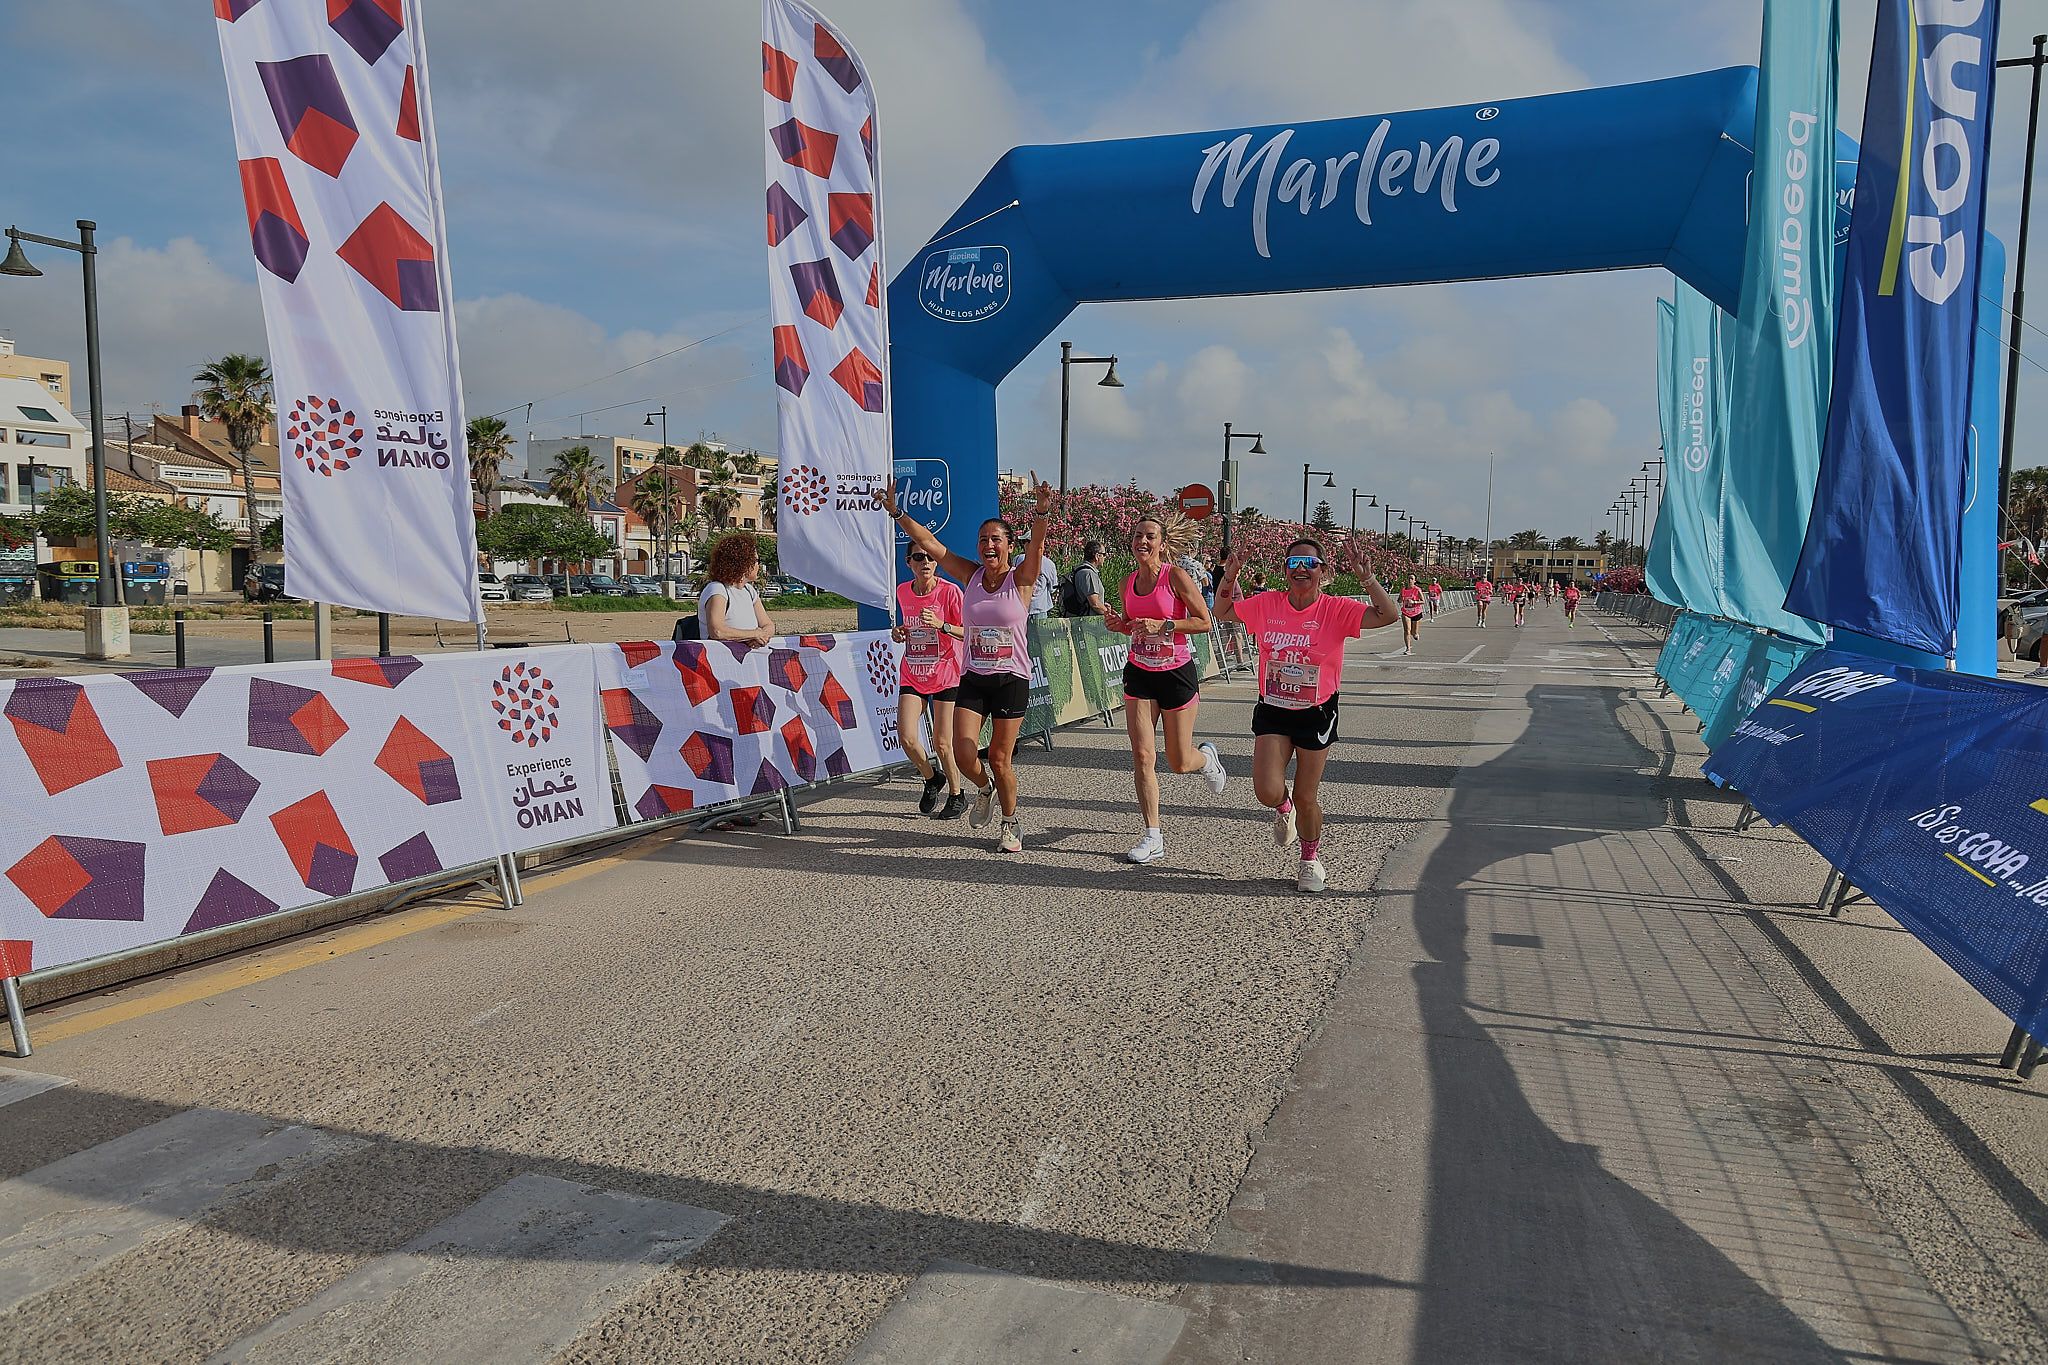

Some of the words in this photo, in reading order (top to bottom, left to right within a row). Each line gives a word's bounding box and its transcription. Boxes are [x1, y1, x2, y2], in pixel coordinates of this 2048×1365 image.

[1191, 118, 1500, 258] Marlene
[925, 263, 1004, 302] Marlene
[928, 300, 943, 314] HIJA
[945, 309, 956, 317] DE
[975, 300, 998, 316] ALPES
[895, 478, 943, 513] rlene
[1263, 631, 1311, 648] CARRERA
[1280, 683, 1301, 693] 016
[1784, 666, 1897, 702] GOYA
[876, 705, 898, 717] Experie
[883, 736, 901, 751] OM
[506, 757, 572, 778] Experience
[517, 797, 584, 829] OMAN
[1934, 825, 1970, 843] es
